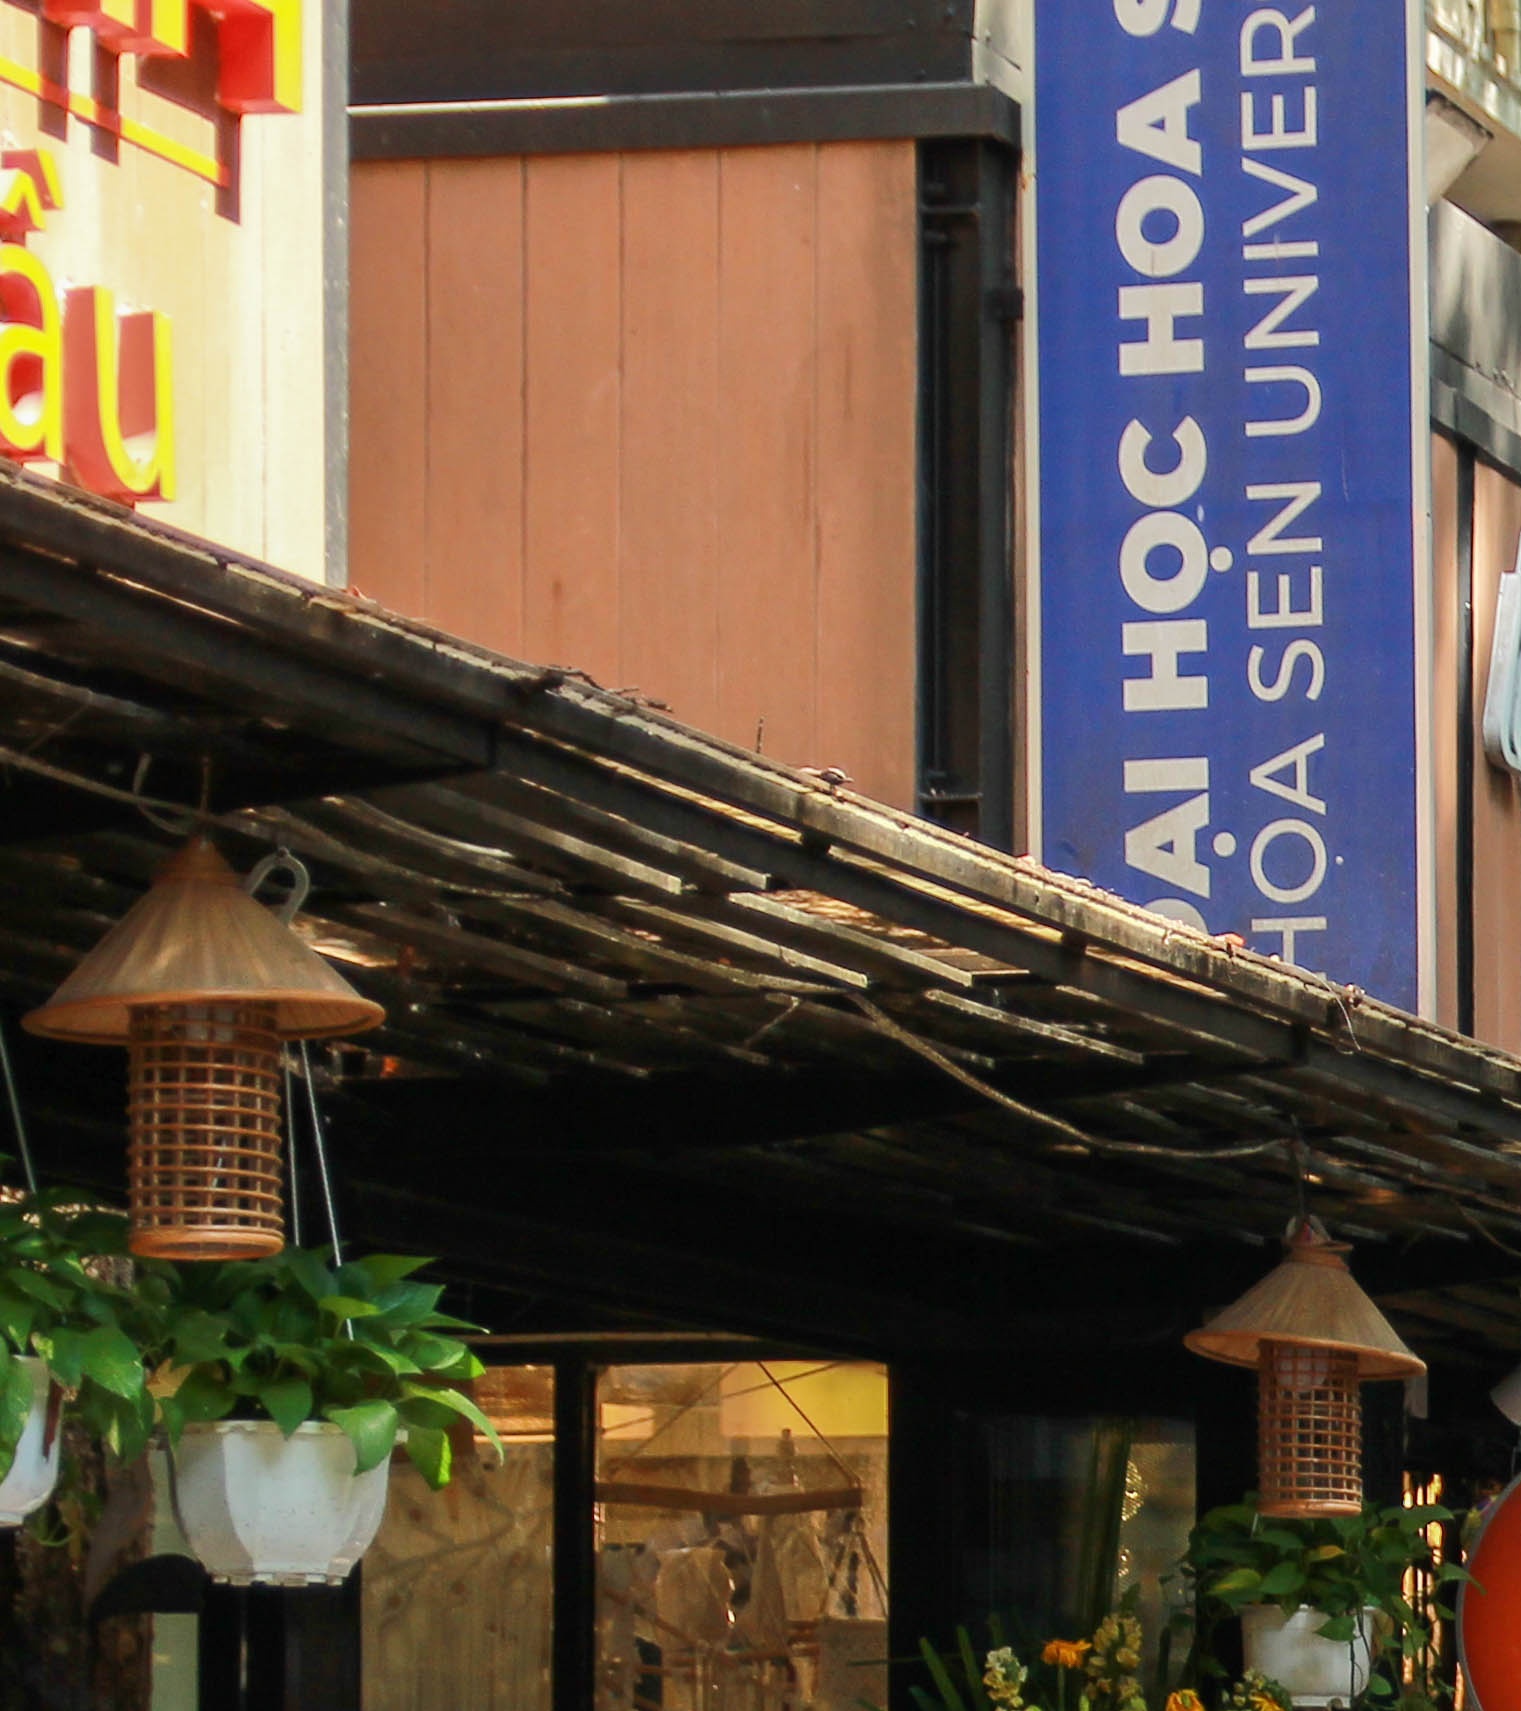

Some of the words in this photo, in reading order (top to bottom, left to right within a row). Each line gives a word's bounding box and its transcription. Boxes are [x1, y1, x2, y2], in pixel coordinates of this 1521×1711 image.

[1115, 68, 1205, 377] HOA
[1239, 4, 1322, 438] UNIVER
[1117, 414, 1234, 713] HỌC
[1245, 481, 1326, 702] SEN
